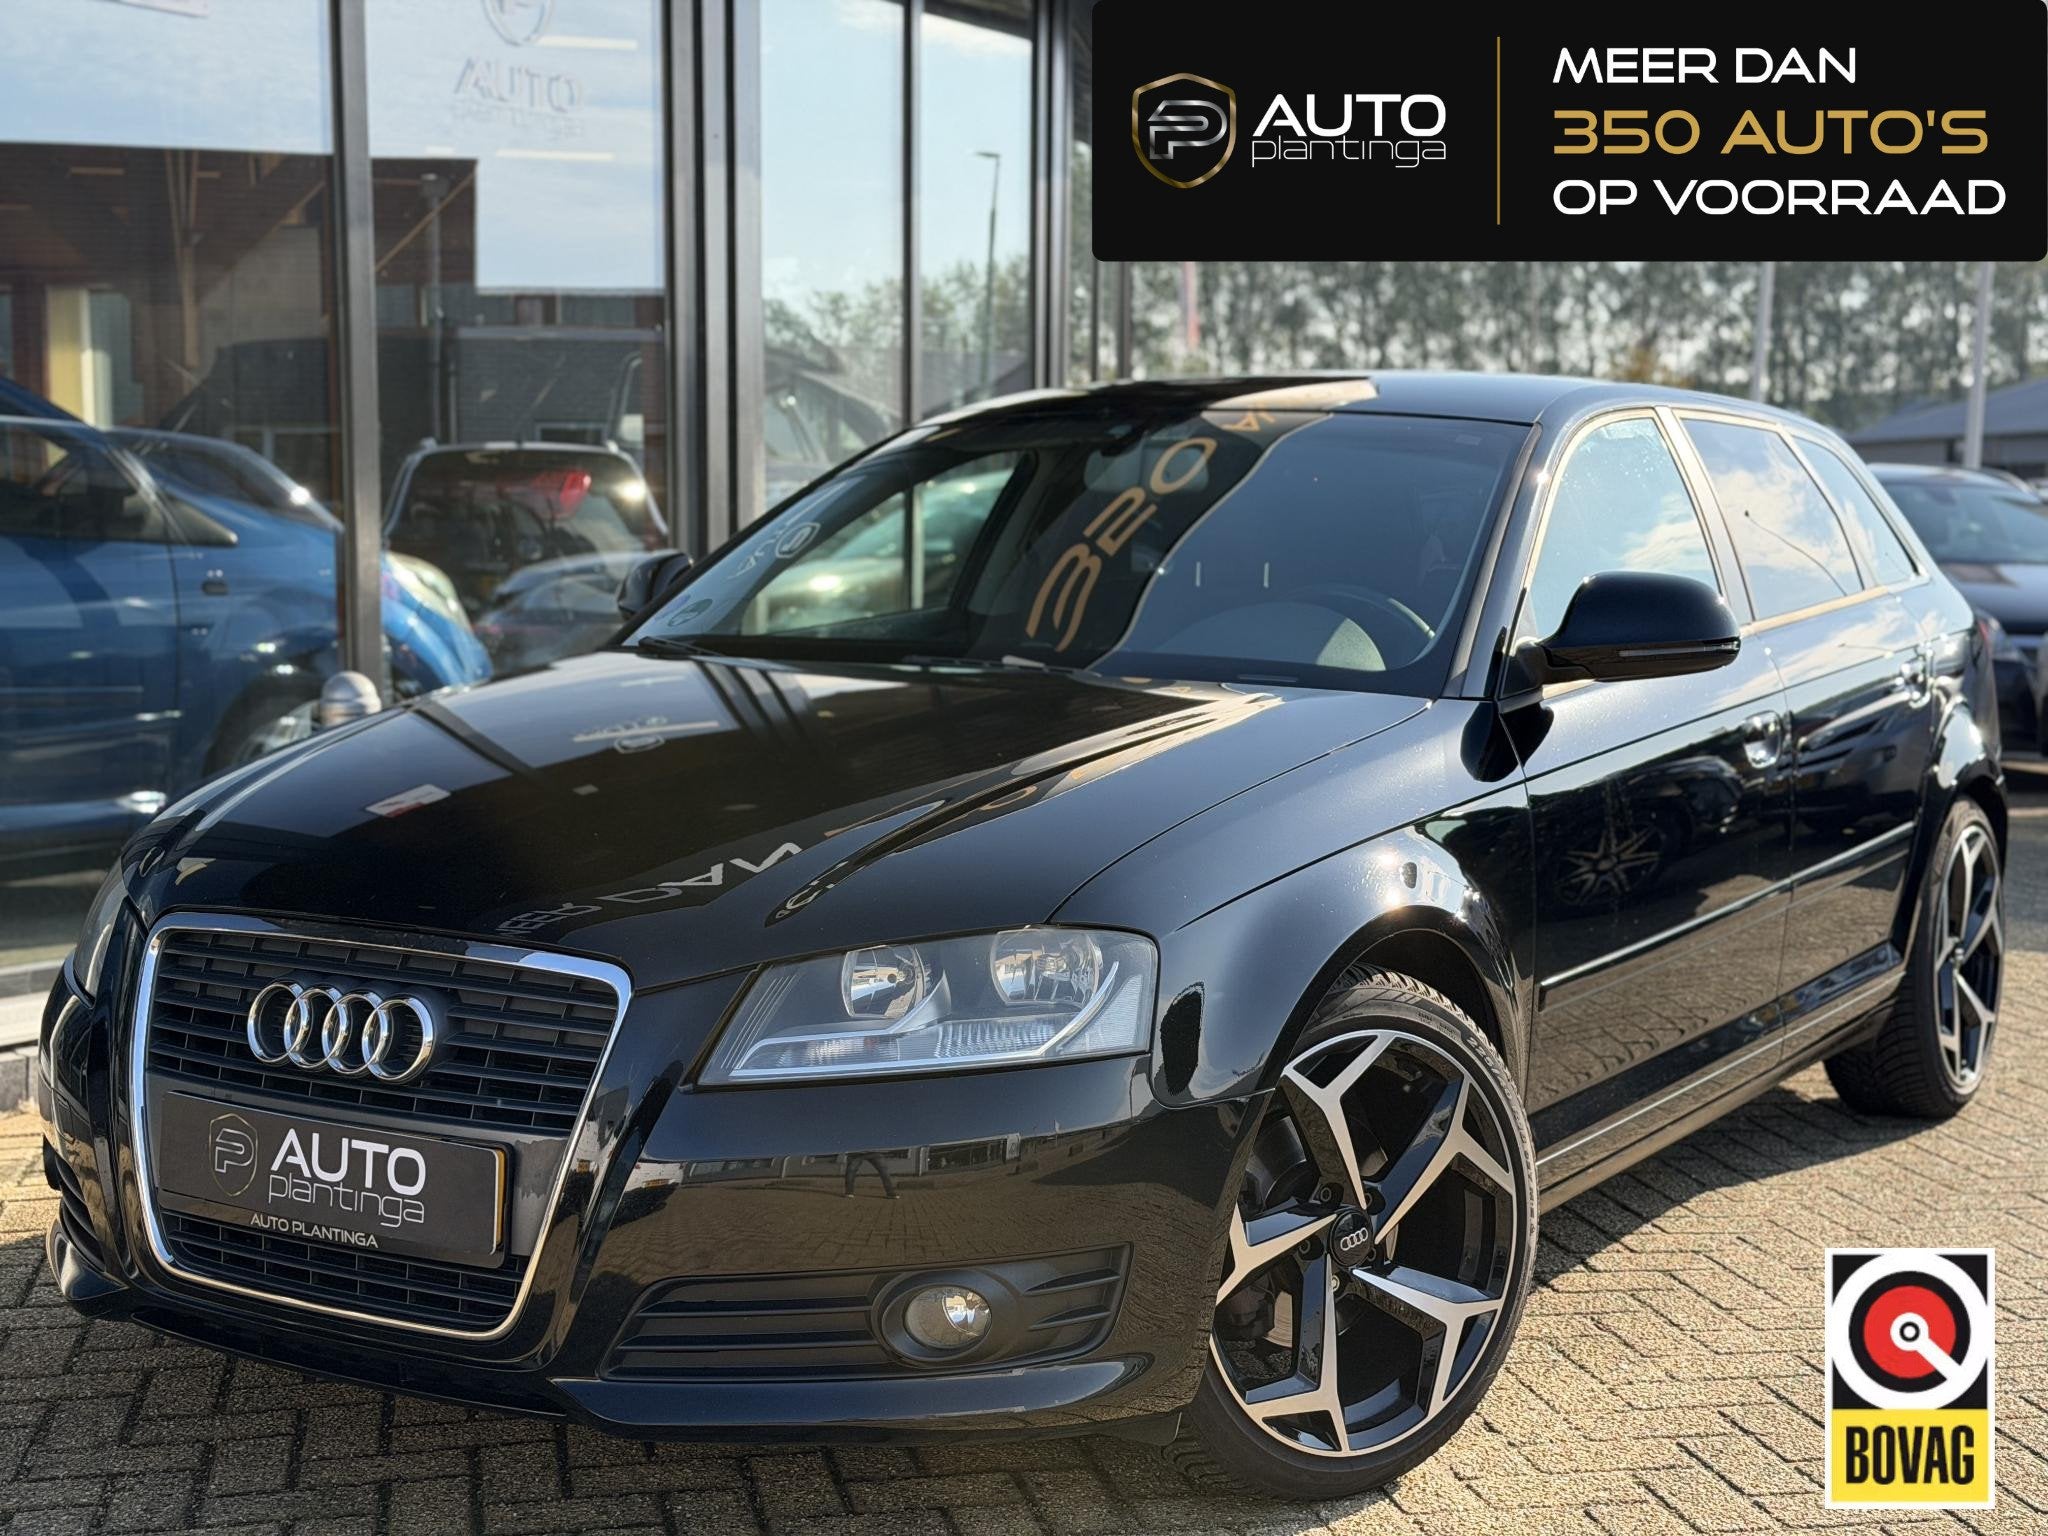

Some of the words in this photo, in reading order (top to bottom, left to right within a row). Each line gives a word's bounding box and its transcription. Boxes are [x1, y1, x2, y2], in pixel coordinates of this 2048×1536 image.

[270, 1128, 426, 1196] AUTO
[268, 1172, 425, 1228] plantinga
[250, 1213, 289, 1232] AUTO
[291, 1220, 379, 1249] PLANTINGA
